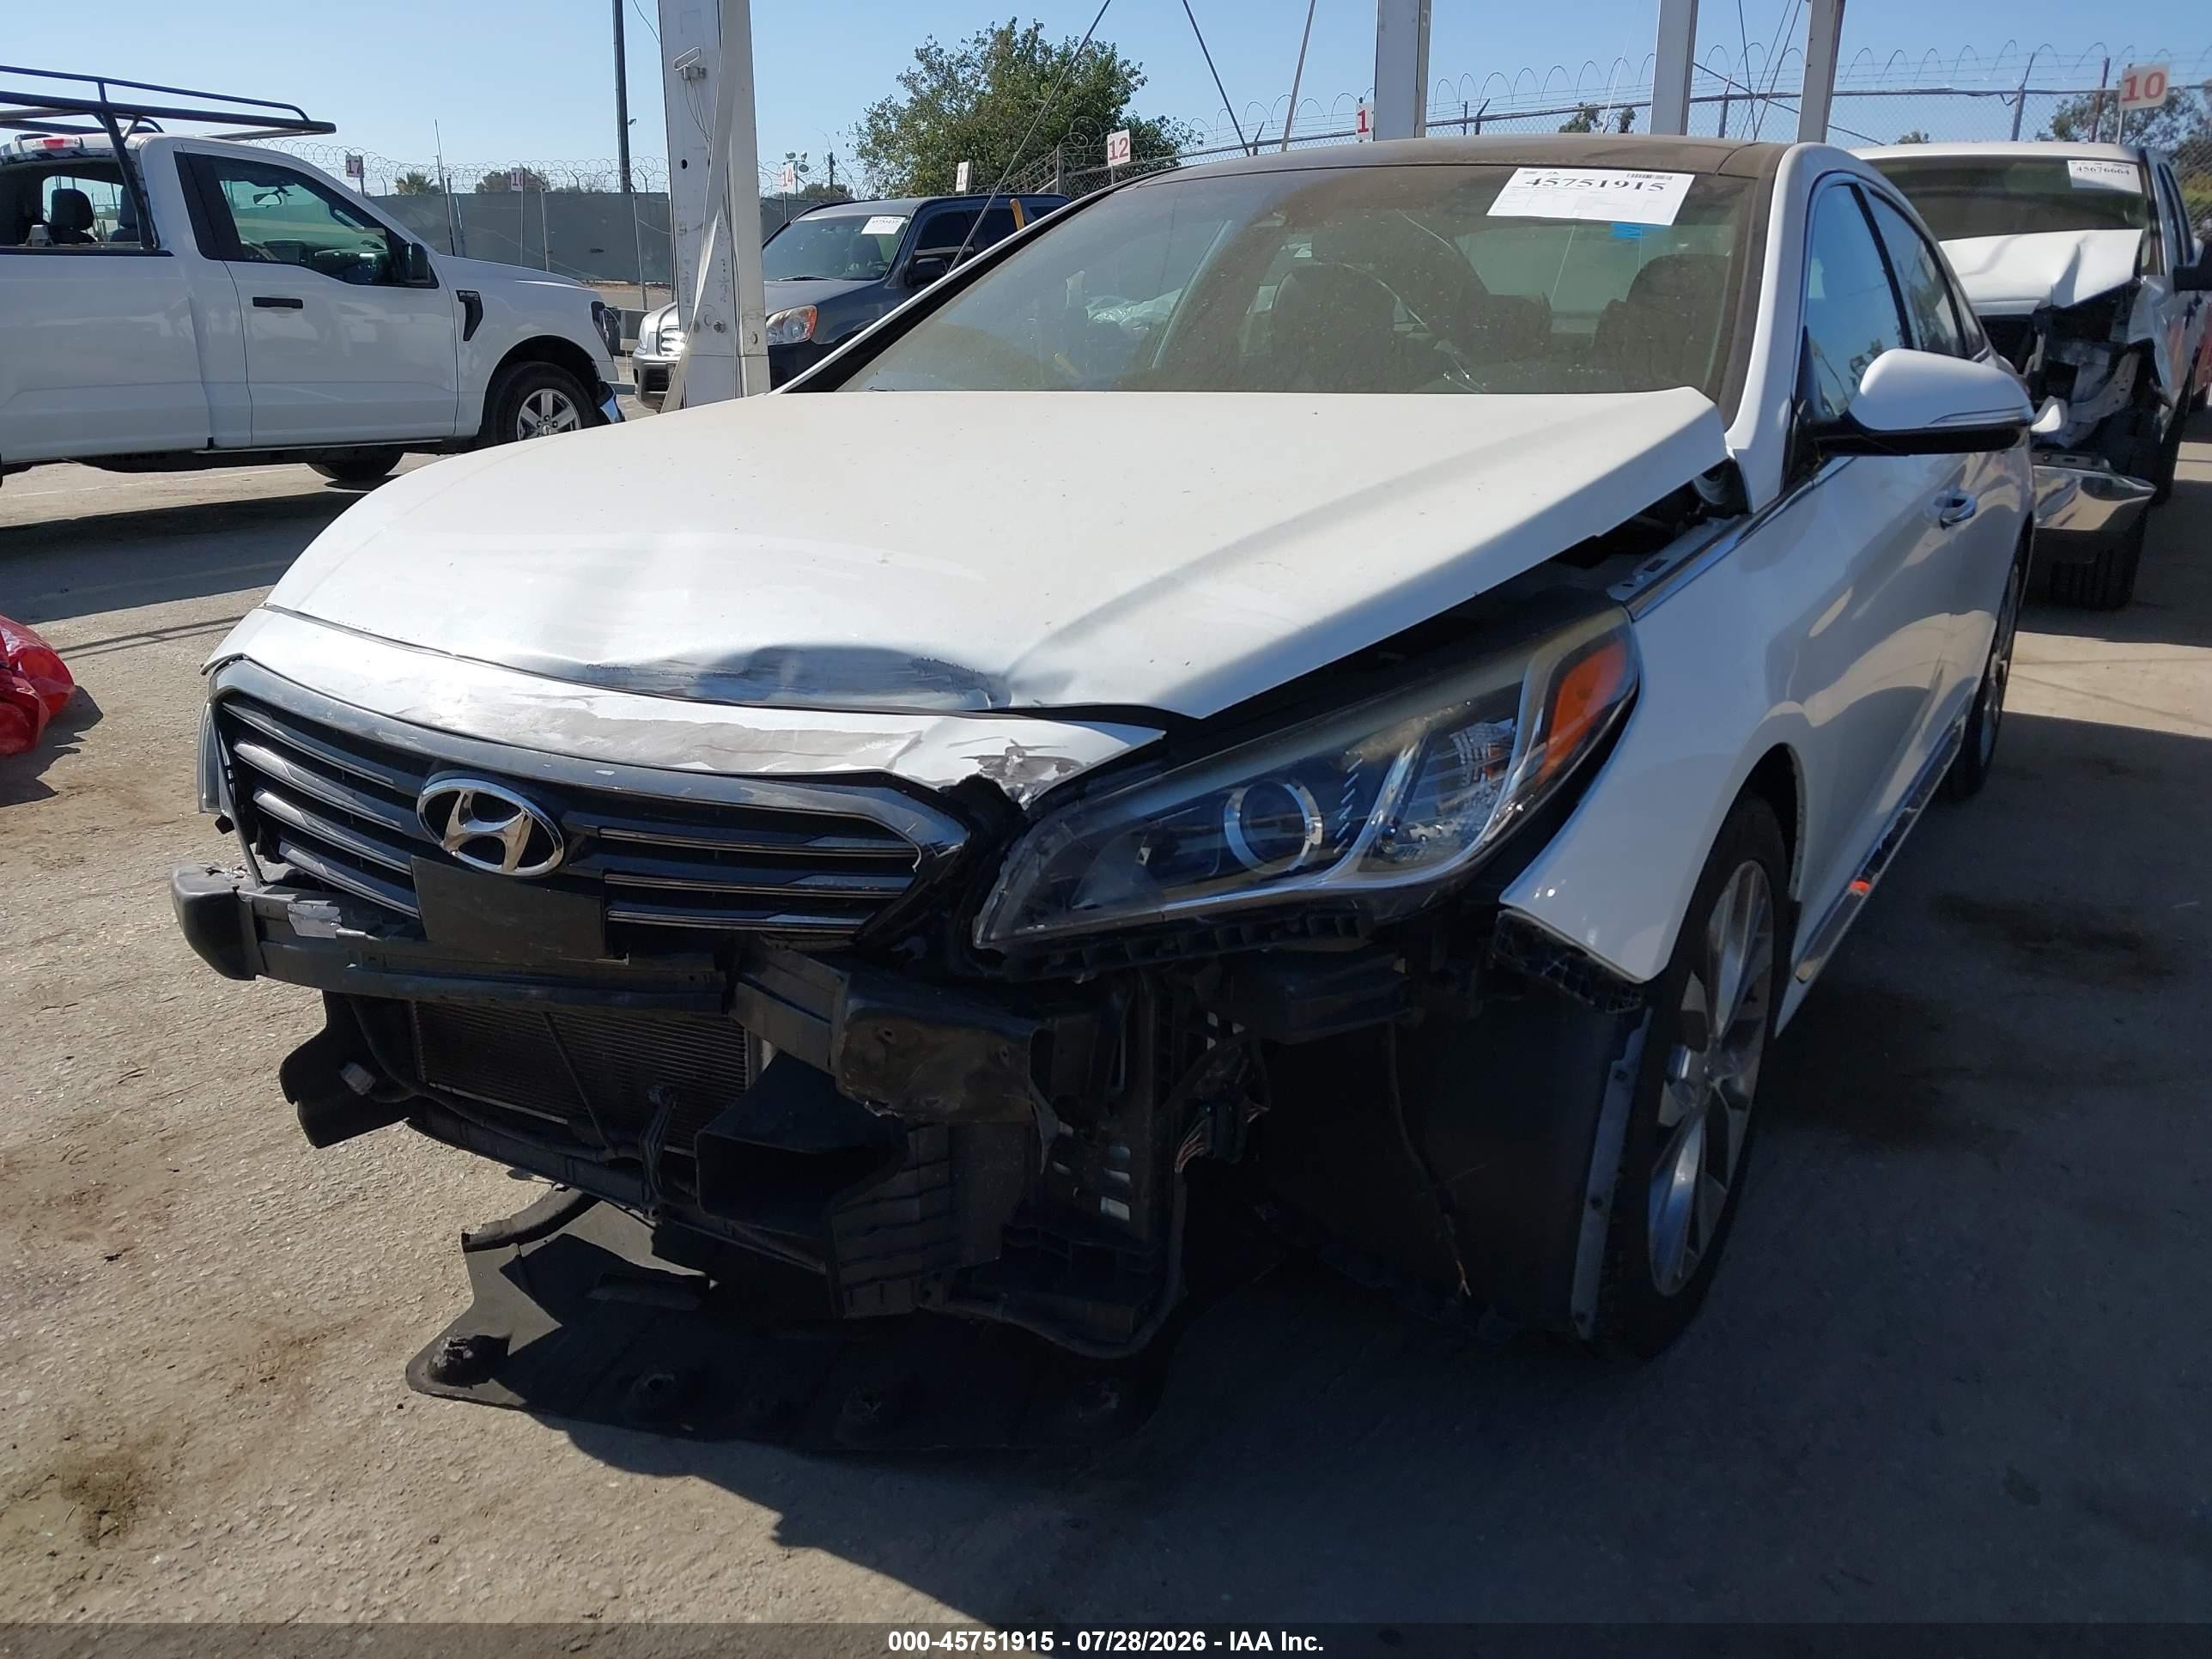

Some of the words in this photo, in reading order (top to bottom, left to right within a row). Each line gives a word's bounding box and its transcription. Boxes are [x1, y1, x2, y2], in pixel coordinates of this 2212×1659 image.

[2122, 71, 2165, 102] 10
[1109, 137, 1128, 161] 12
[1525, 177, 1667, 192] 45751915
